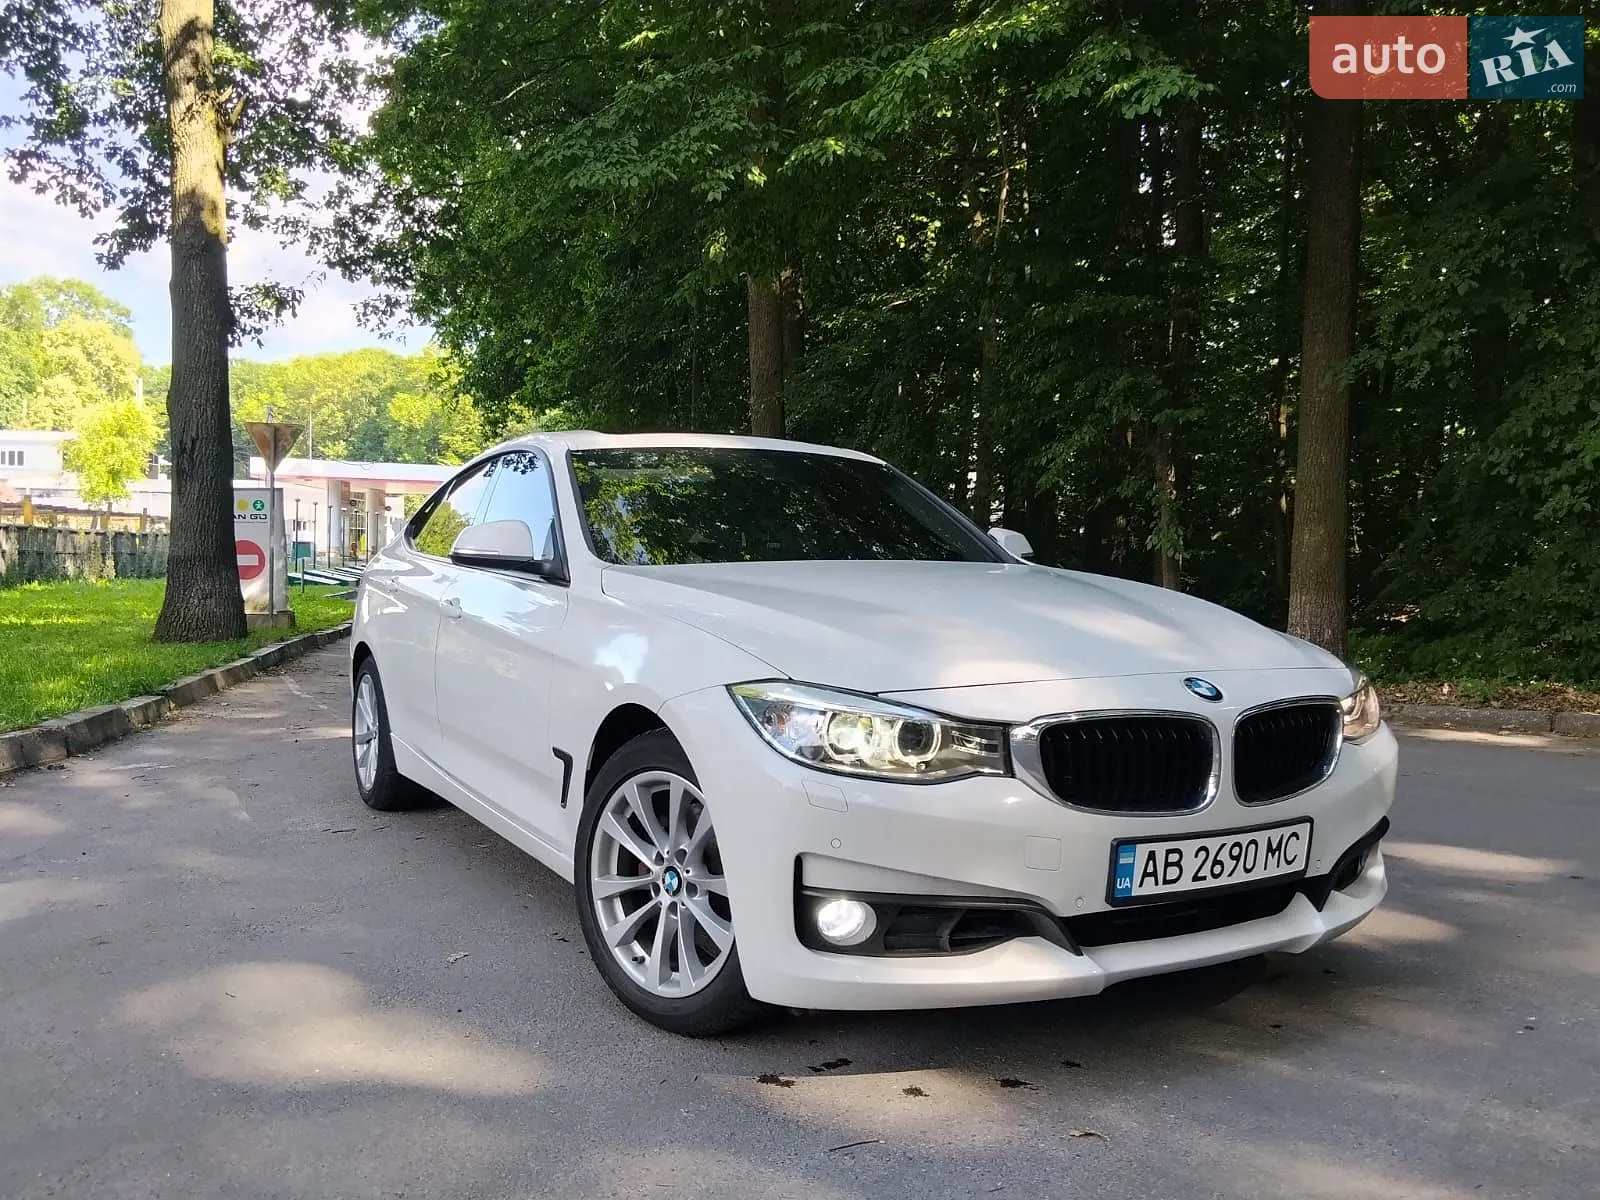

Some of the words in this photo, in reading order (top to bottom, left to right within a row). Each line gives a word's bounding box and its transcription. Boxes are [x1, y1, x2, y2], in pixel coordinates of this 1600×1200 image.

[1138, 847, 1184, 888] AB
[1191, 838, 1259, 883] 2690
[1263, 831, 1300, 871] MC
[1116, 877, 1131, 890] UA
